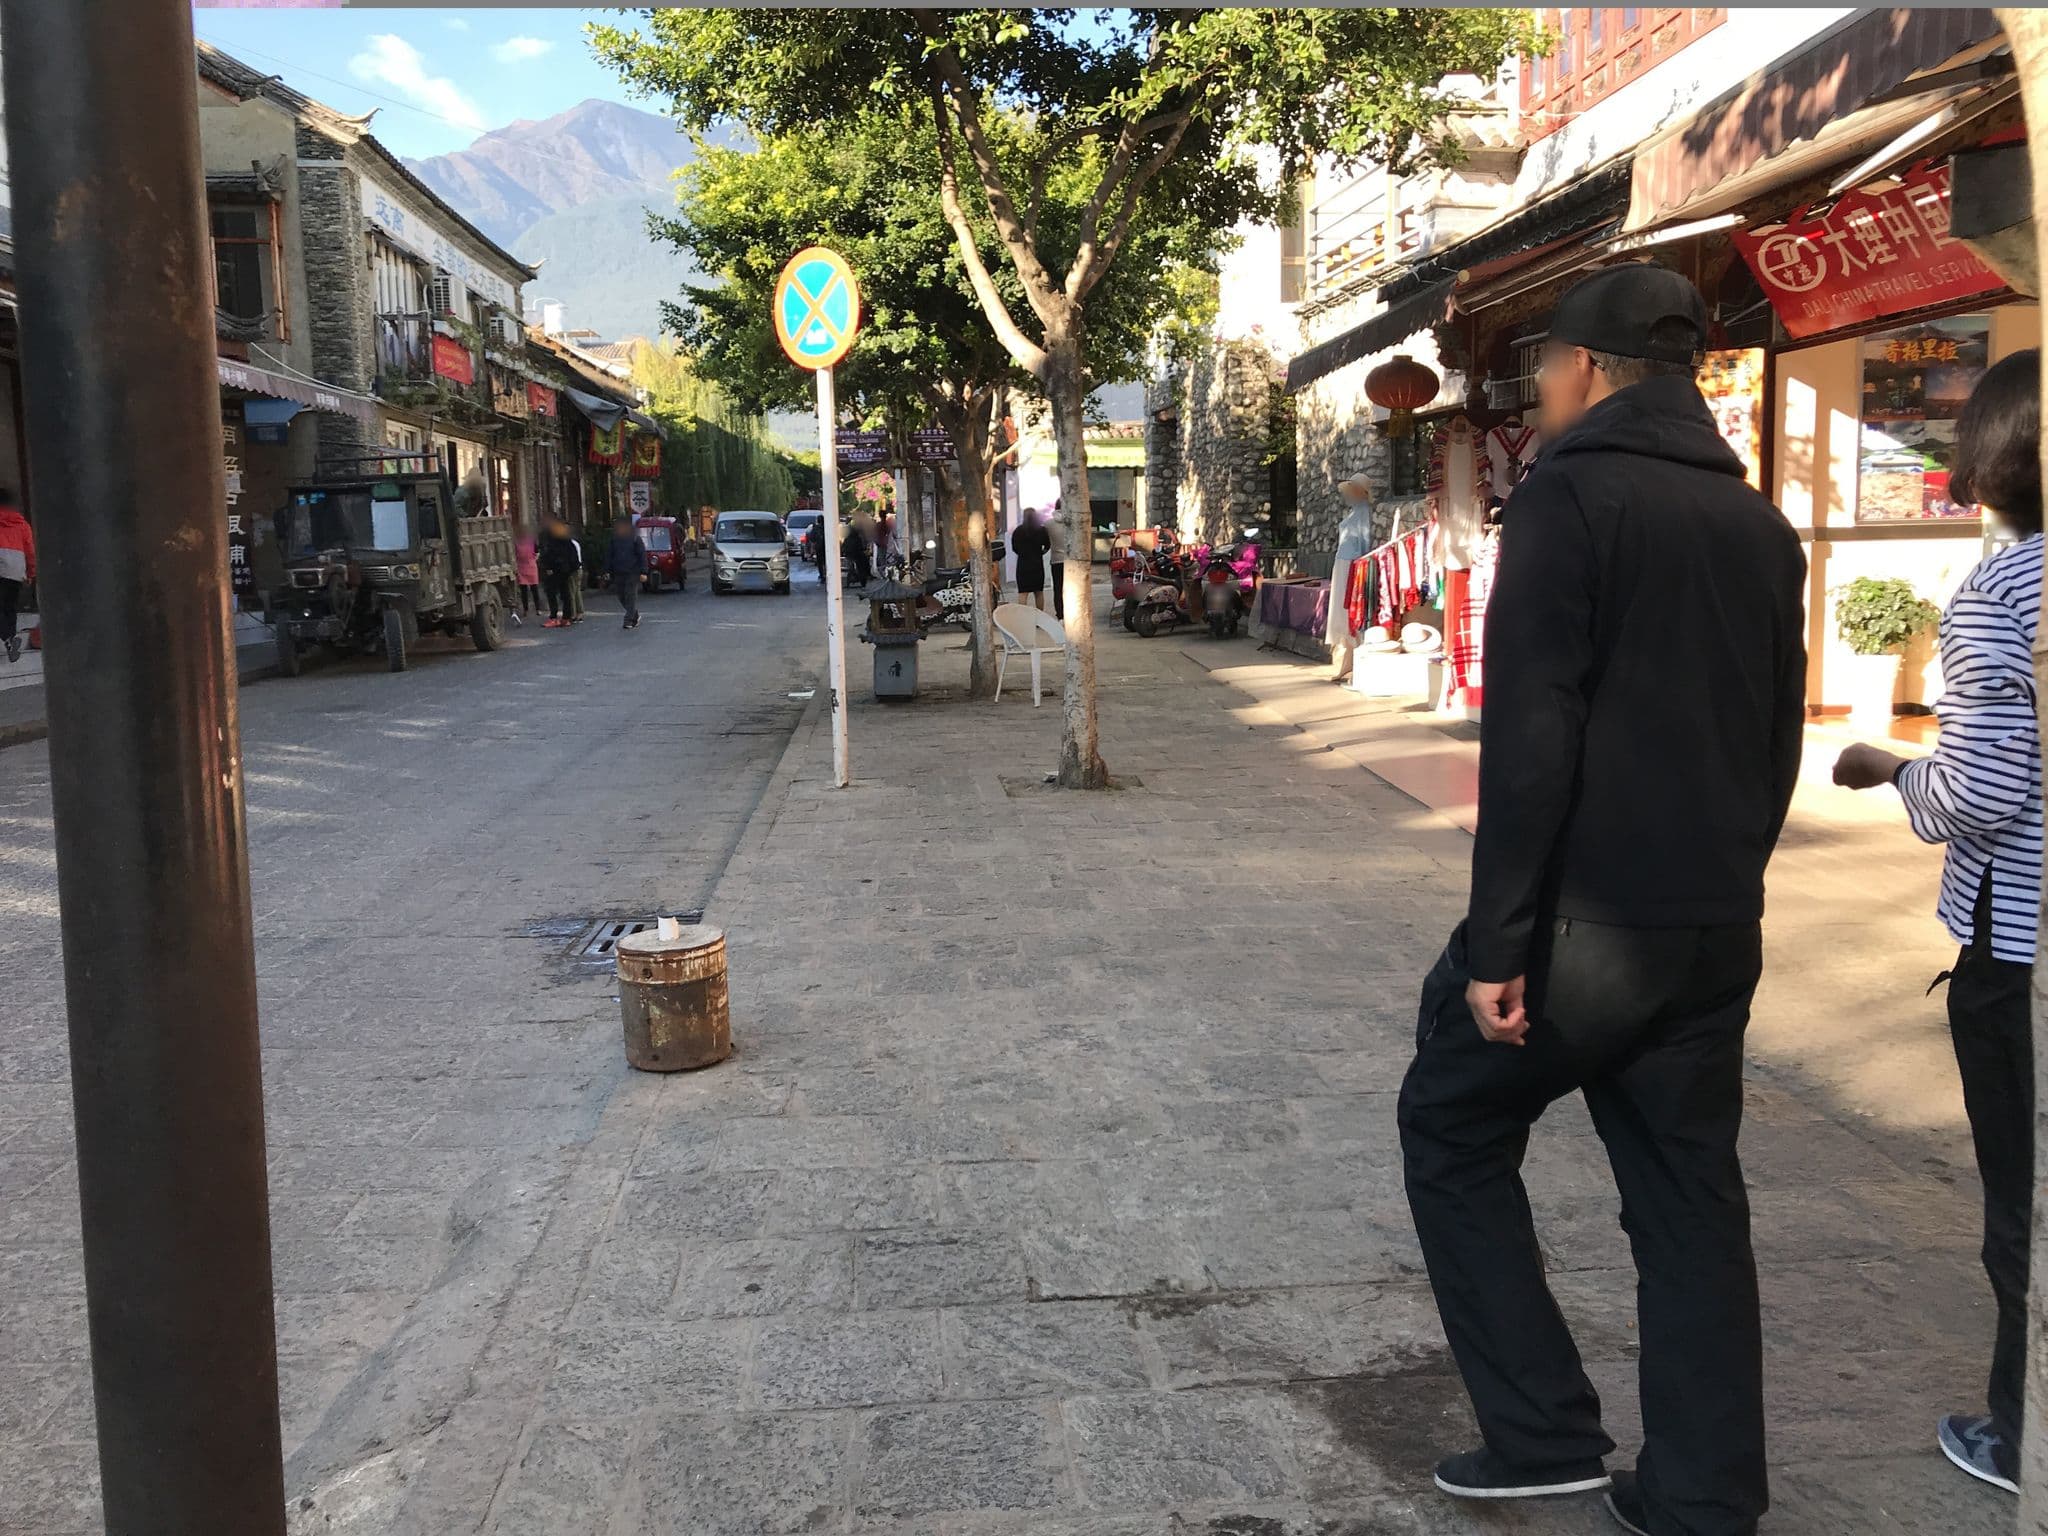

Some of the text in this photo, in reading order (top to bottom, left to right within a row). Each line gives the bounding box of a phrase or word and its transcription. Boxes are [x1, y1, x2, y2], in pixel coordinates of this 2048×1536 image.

[1821, 174, 1959, 278] 大理中国
[1801, 298, 1832, 318] DALI
[1831, 286, 1874, 312] CHINA
[1871, 273, 1931, 302] TRAVEL
[1886, 338, 1959, 363] 香格里拉
